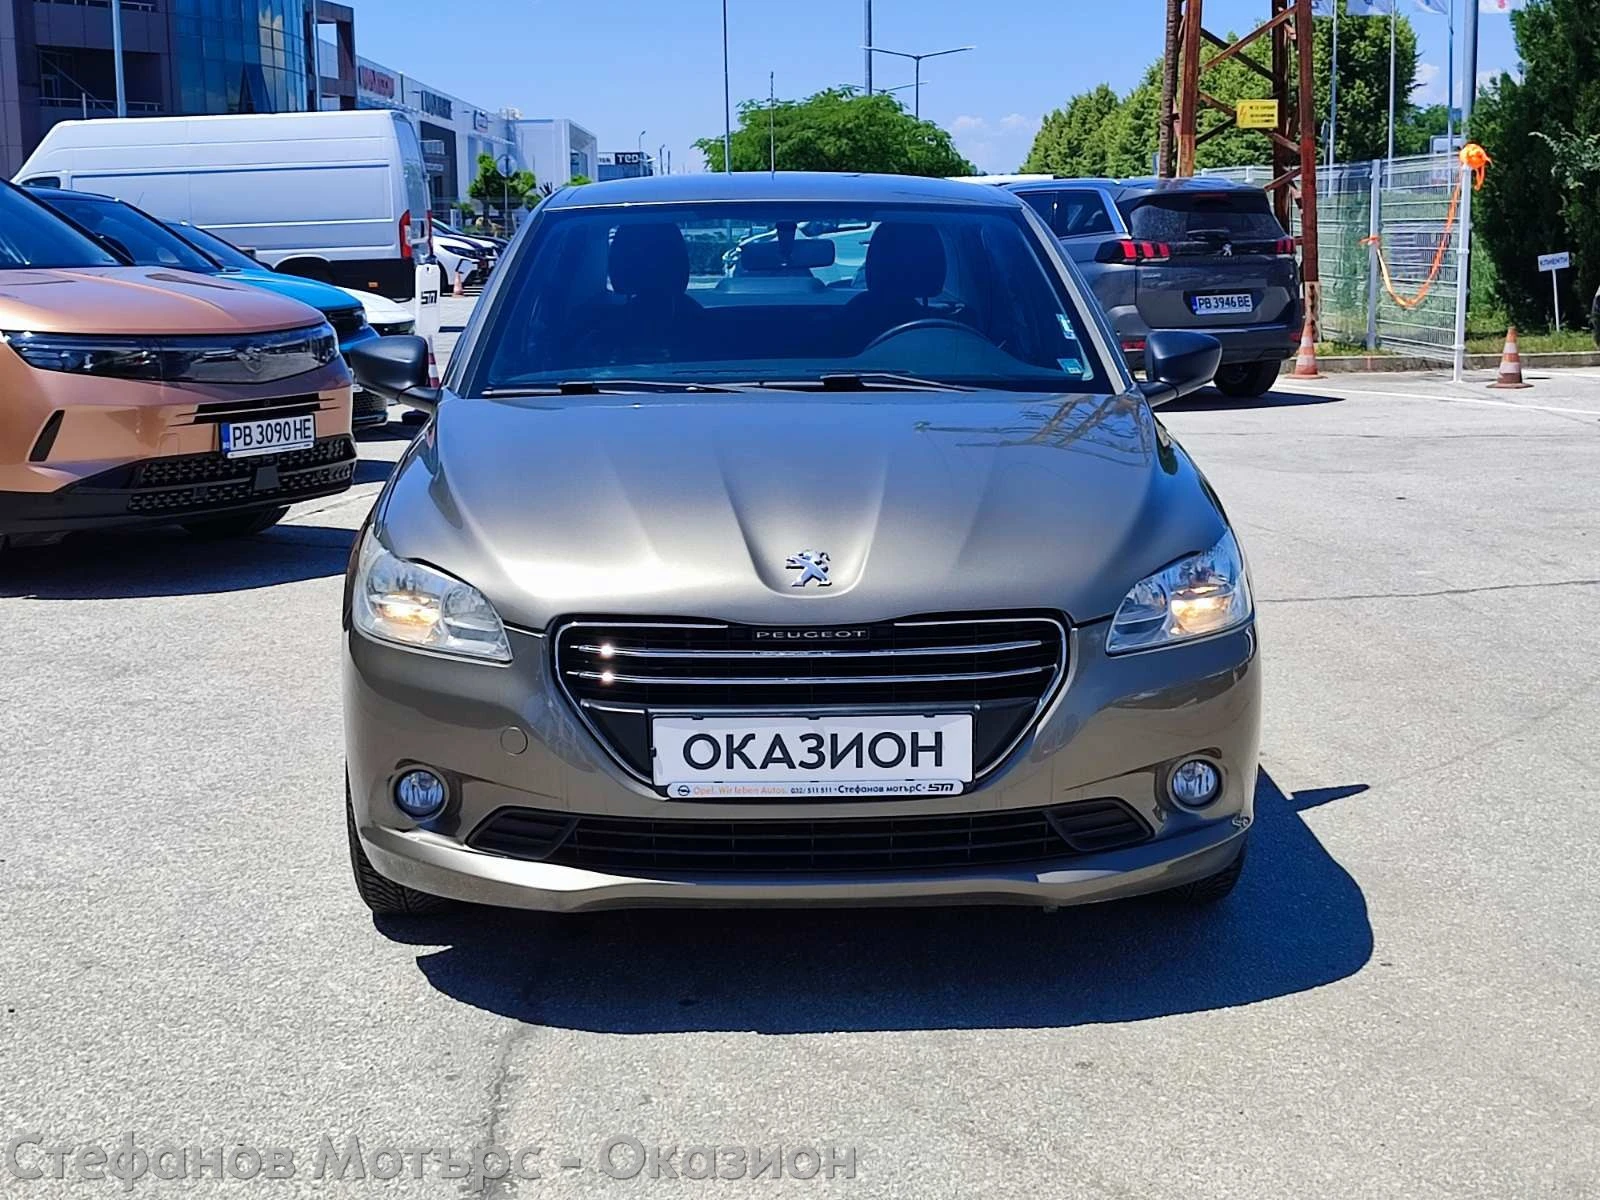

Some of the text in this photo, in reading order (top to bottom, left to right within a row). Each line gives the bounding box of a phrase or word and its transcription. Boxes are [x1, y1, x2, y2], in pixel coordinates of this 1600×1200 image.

[1198, 295, 1251, 309] PB 3946 BE
[232, 418, 312, 448] PB 3090 HE
[756, 630, 866, 639] PEUGEOT
[682, 731, 944, 771] ОКАЗИОН
